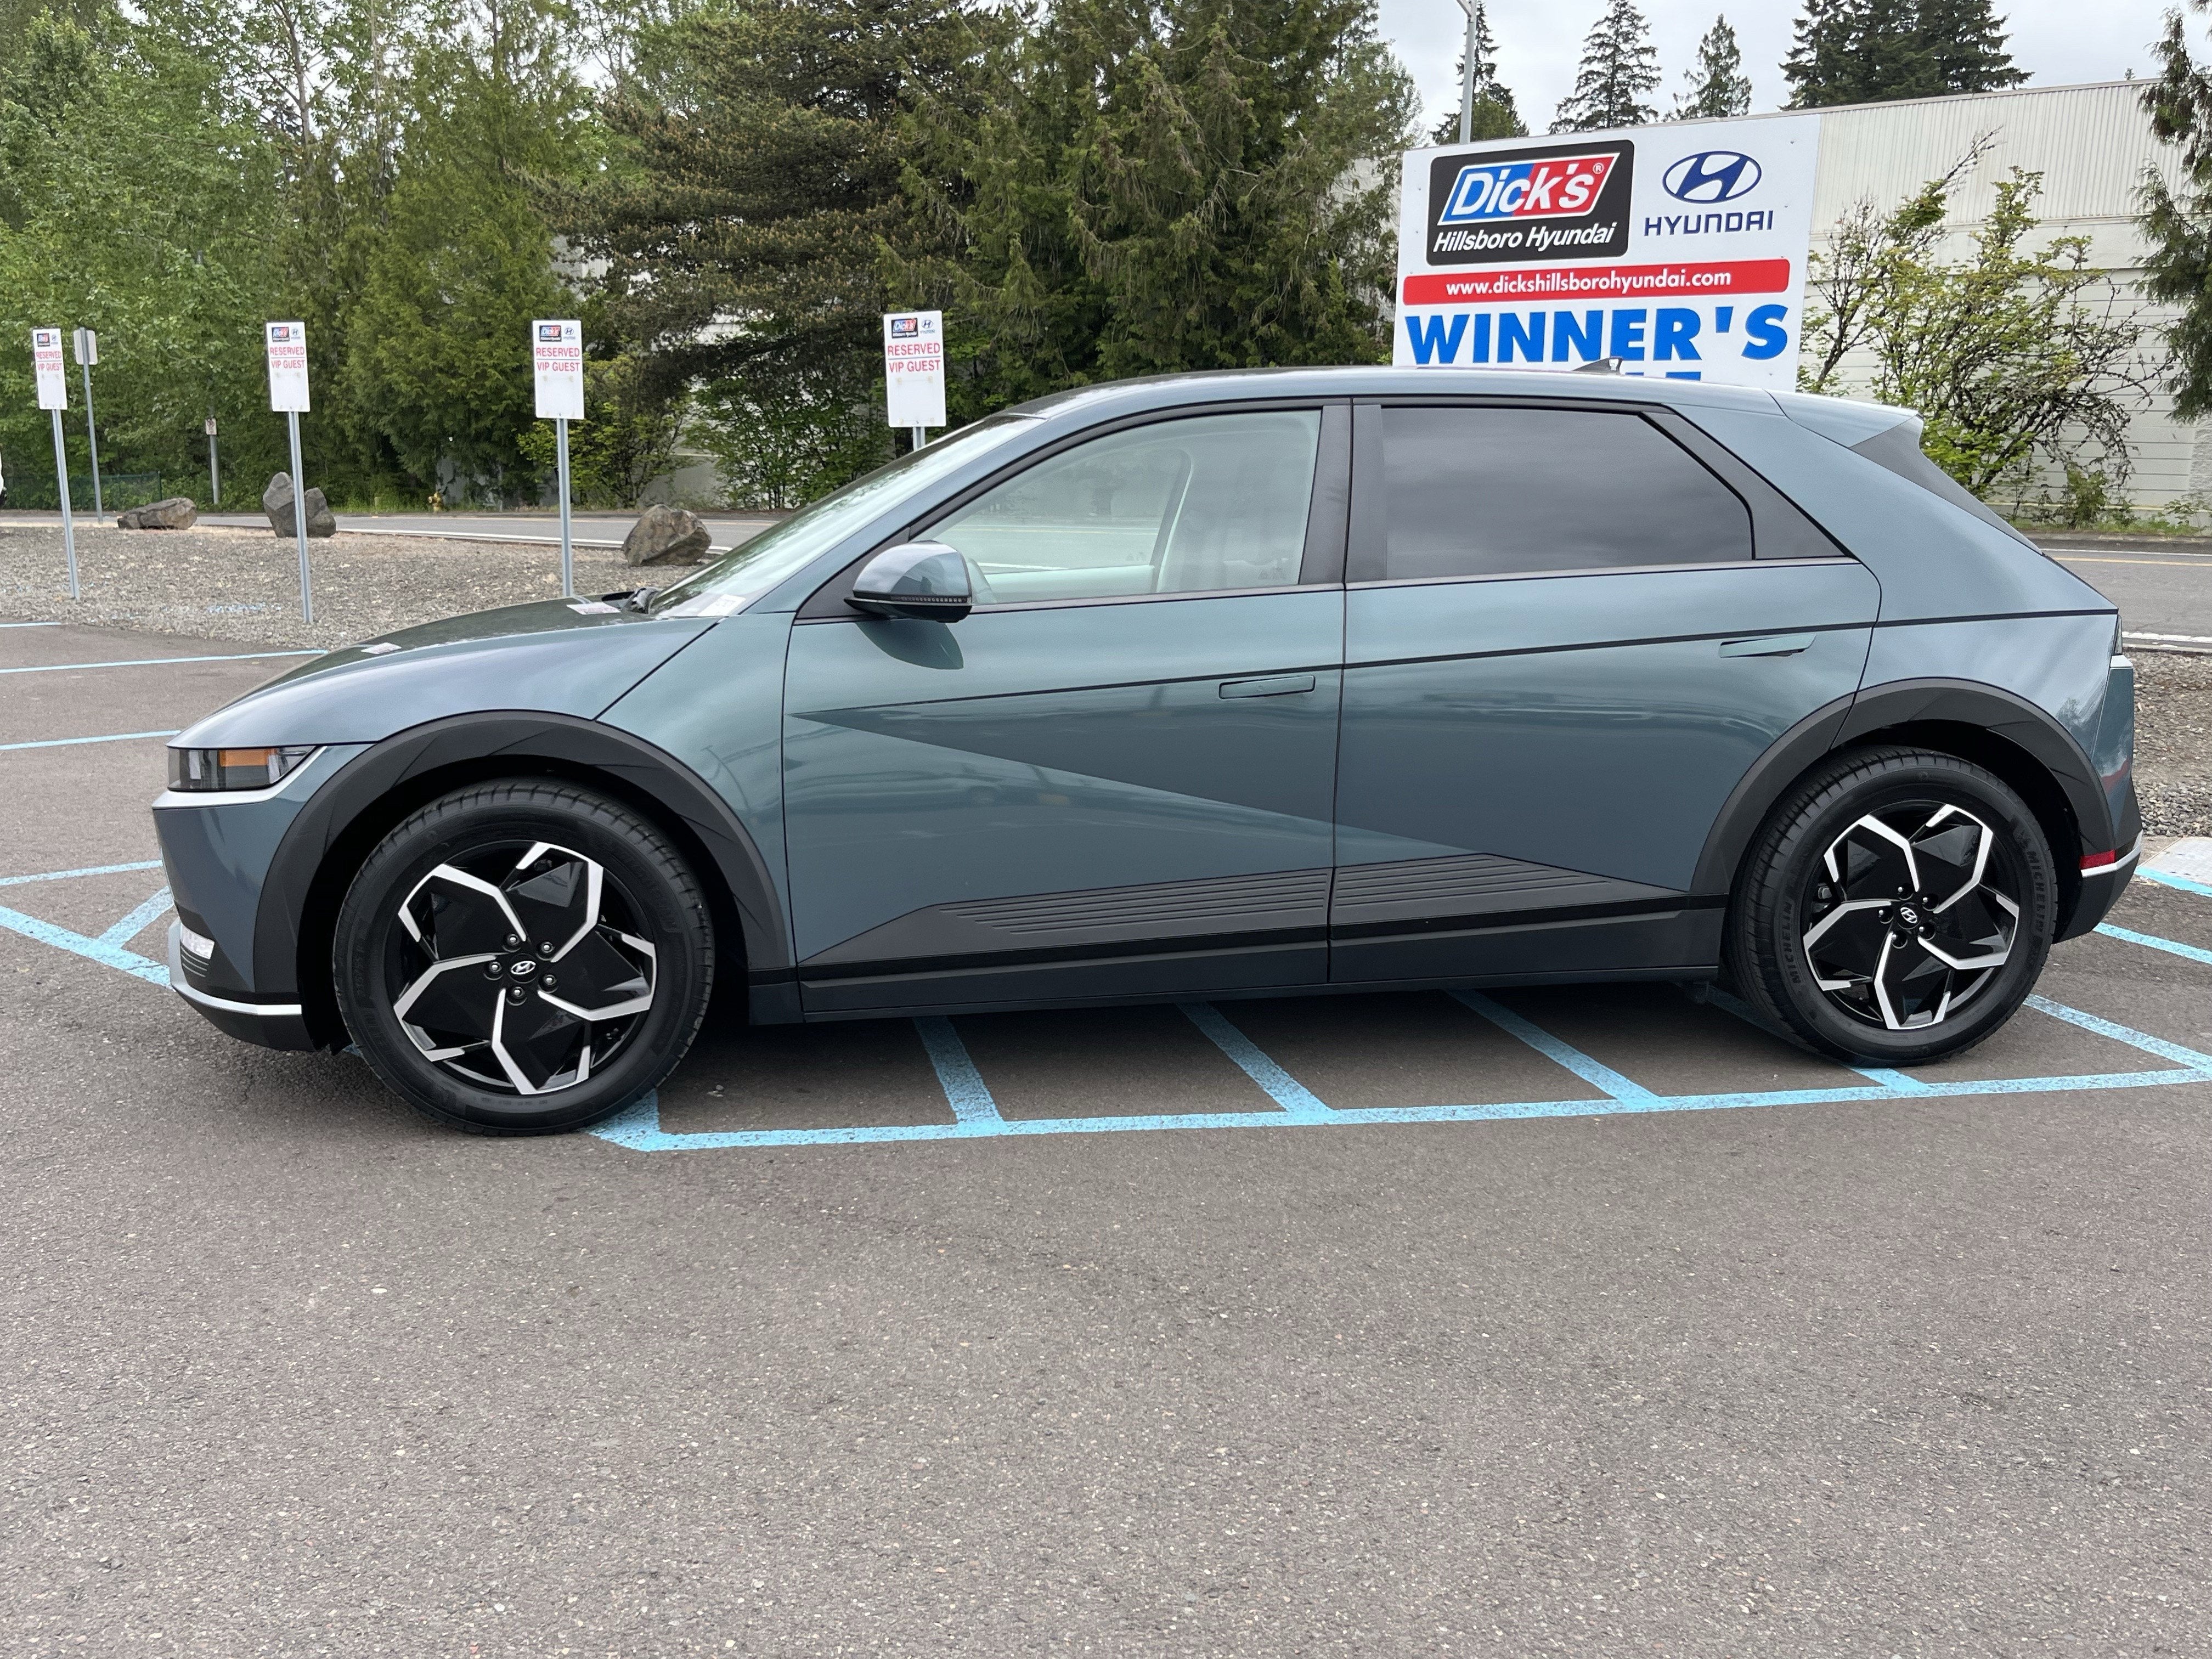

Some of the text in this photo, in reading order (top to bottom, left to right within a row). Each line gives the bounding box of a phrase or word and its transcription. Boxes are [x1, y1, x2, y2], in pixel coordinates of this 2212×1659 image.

[1644, 210, 1774, 236] HYUNDAI
[1433, 222, 1617, 252] Hillsboro Hyundai
[1446, 268, 1731, 295] www.dickshillsborohyundai.com
[1404, 304, 1788, 365] WINNER'S
[269, 346, 305, 356] RESERVED
[535, 347, 580, 357] RESERVED
[887, 343, 940, 356] RESERVED
[46, 362, 63, 371] GUEST
[271, 359, 305, 369] VIP GUEST
[537, 362, 580, 372] VIP GUEST
[888, 360, 941, 373] VIP GUEST
